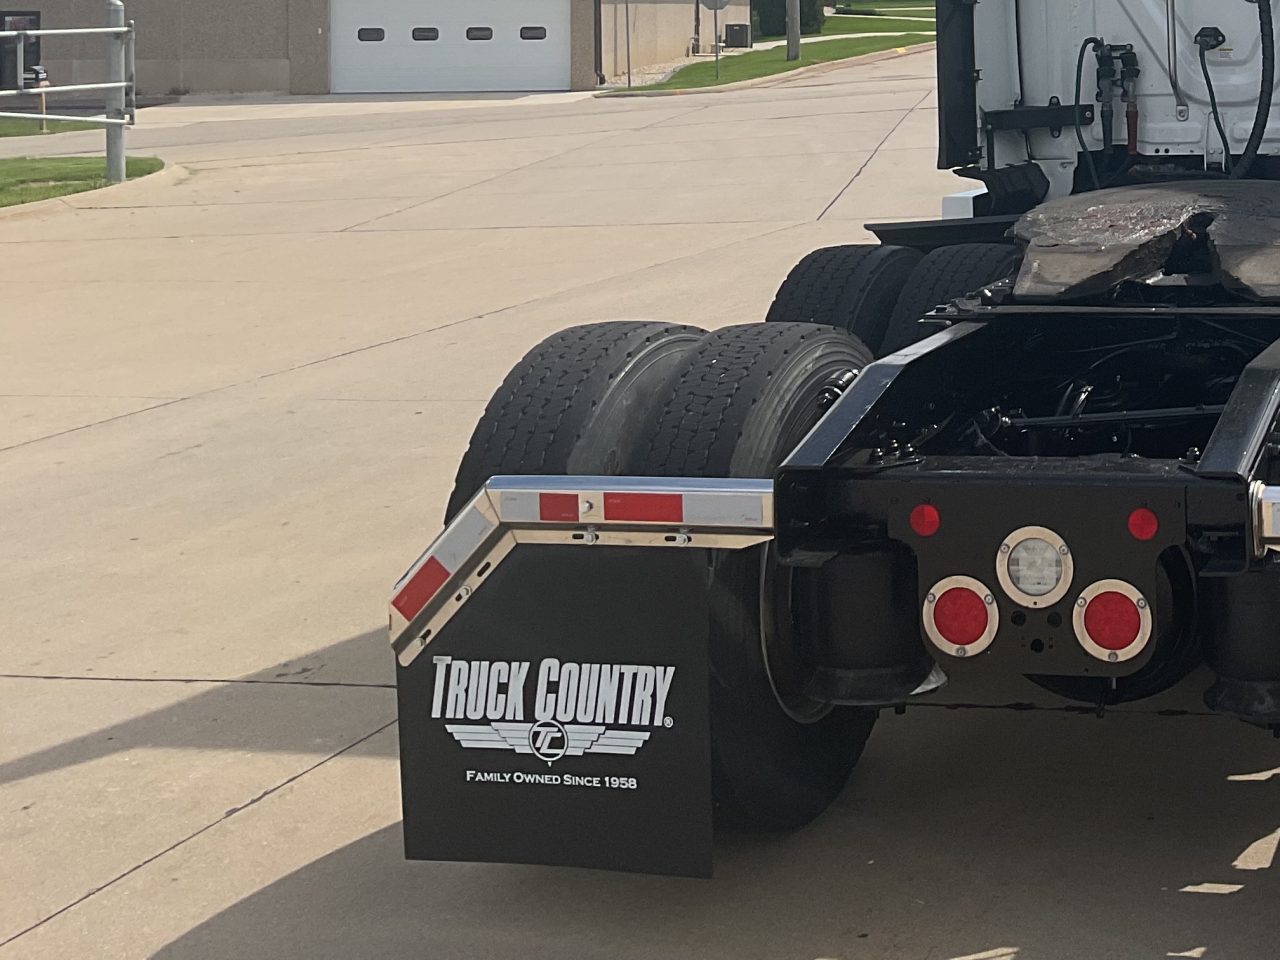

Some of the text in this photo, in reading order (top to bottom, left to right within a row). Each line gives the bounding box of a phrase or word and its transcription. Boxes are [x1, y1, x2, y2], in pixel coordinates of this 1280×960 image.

[431, 656, 530, 720] TRUCK
[466, 770, 637, 789] FAMILY OWNED SINCE 1958
